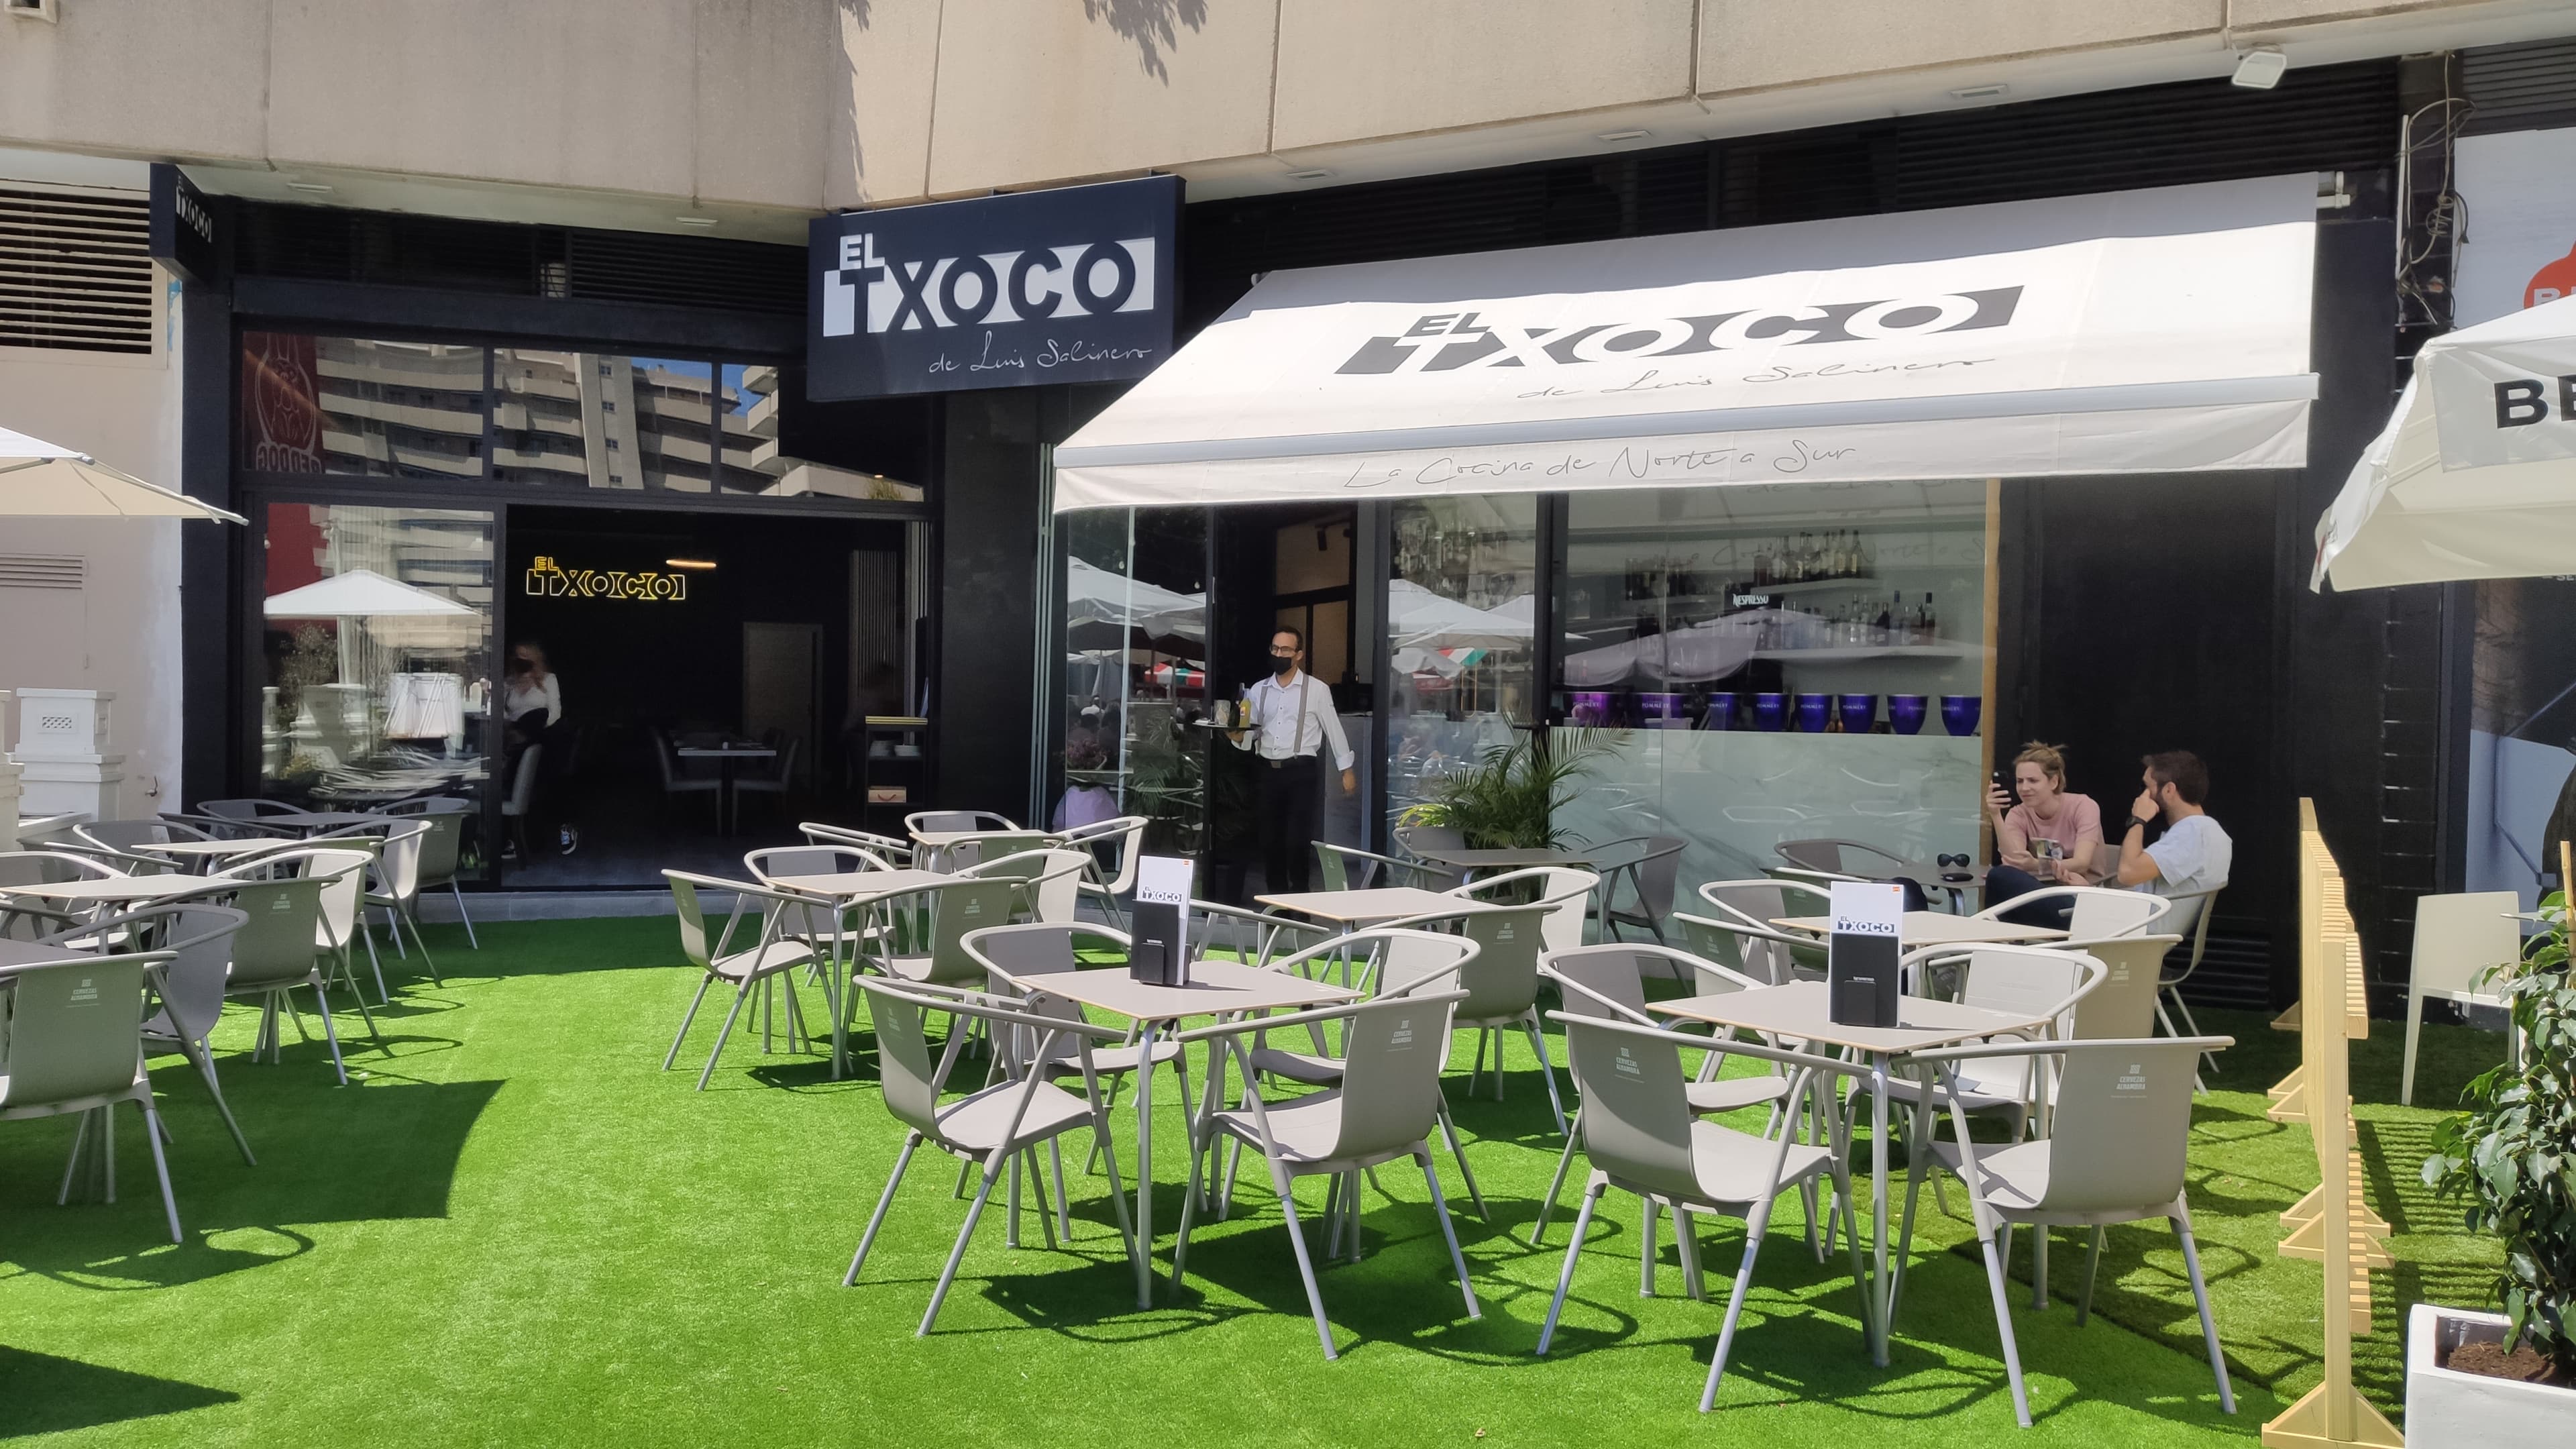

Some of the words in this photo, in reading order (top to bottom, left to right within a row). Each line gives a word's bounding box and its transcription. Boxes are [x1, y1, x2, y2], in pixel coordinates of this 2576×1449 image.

[839, 233, 885, 270] EL
[823, 236, 1156, 337] TXOCO
[1334, 285, 2025, 374] TXOCO
[1401, 312, 1491, 337] EL
[928, 353, 961, 373] de
[969, 330, 1025, 371] Luis
[1036, 339, 1152, 368] Salinero
[1517, 385, 1584, 398] de
[1600, 370, 1713, 394] Luis
[1742, 358, 1996, 382] Salinero
[1344, 461, 1402, 488] La
[1415, 457, 1534, 484] Cocina
[1546, 454, 1597, 476] de
[1609, 447, 1738, 478] Norte
[1739, 452, 1756, 463] a
[1773, 439, 1857, 473] Sur
[535, 556, 559, 571] EL
[526, 569, 686, 600] TXOCO
[1733, 593, 1769, 608] NESPRESSO
[1142, 890, 1182, 902] TXOCO
[1837, 920, 1895, 933] TXOCO
